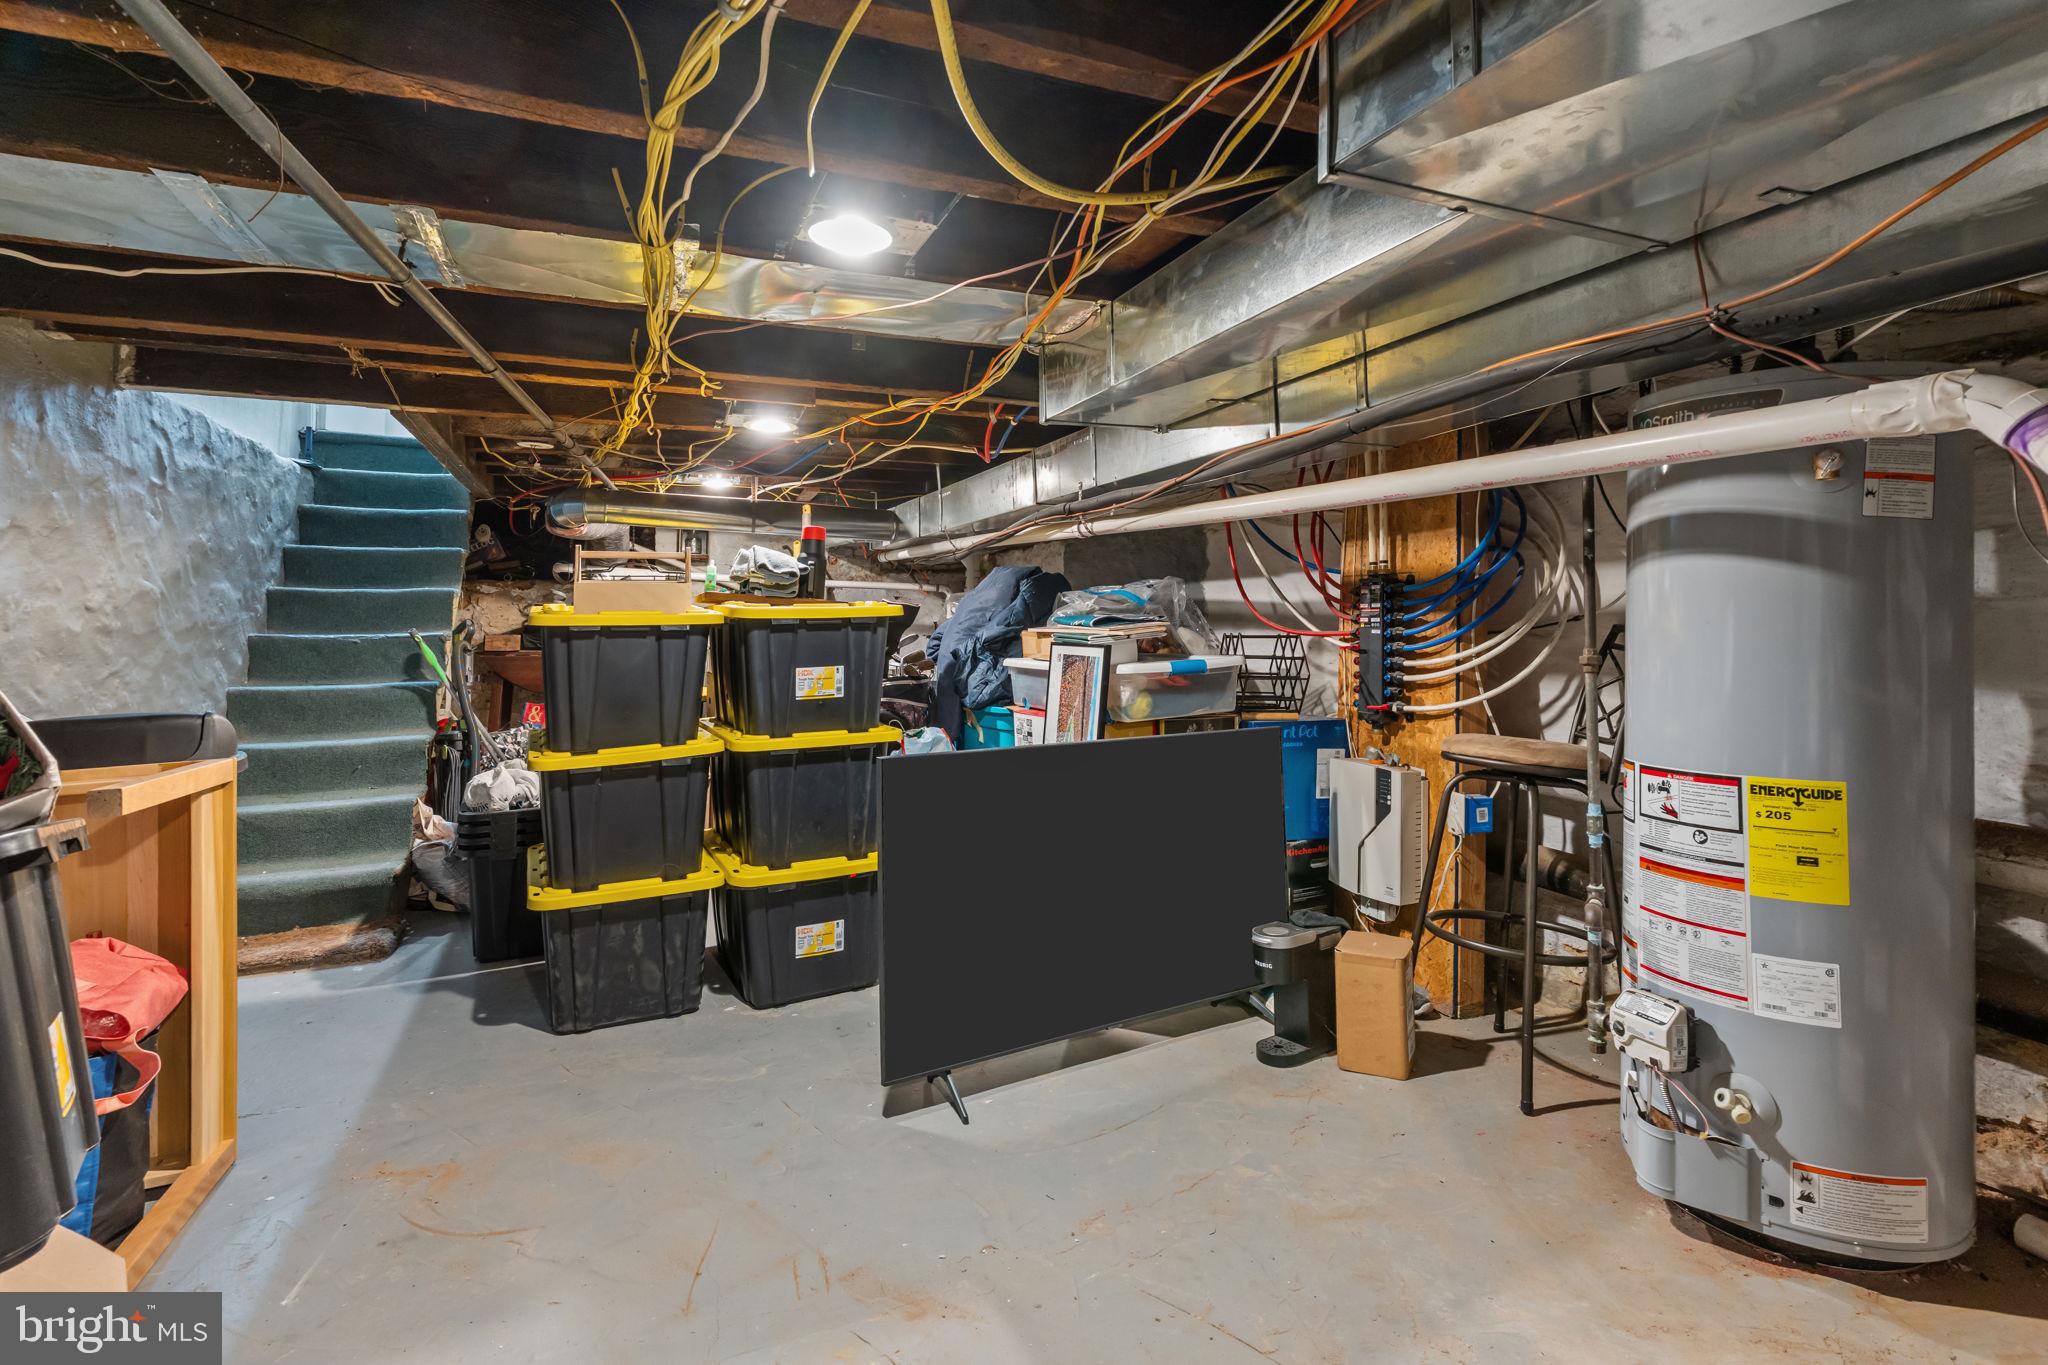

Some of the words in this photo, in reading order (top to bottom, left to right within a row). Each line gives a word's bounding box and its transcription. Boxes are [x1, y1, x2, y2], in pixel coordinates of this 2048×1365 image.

[528, 705, 542, 722] &
[1750, 784, 1843, 802] ENERGYGUIDE
[1765, 810, 1792, 821] 205
[1286, 844, 1329, 857] KitchenAi
